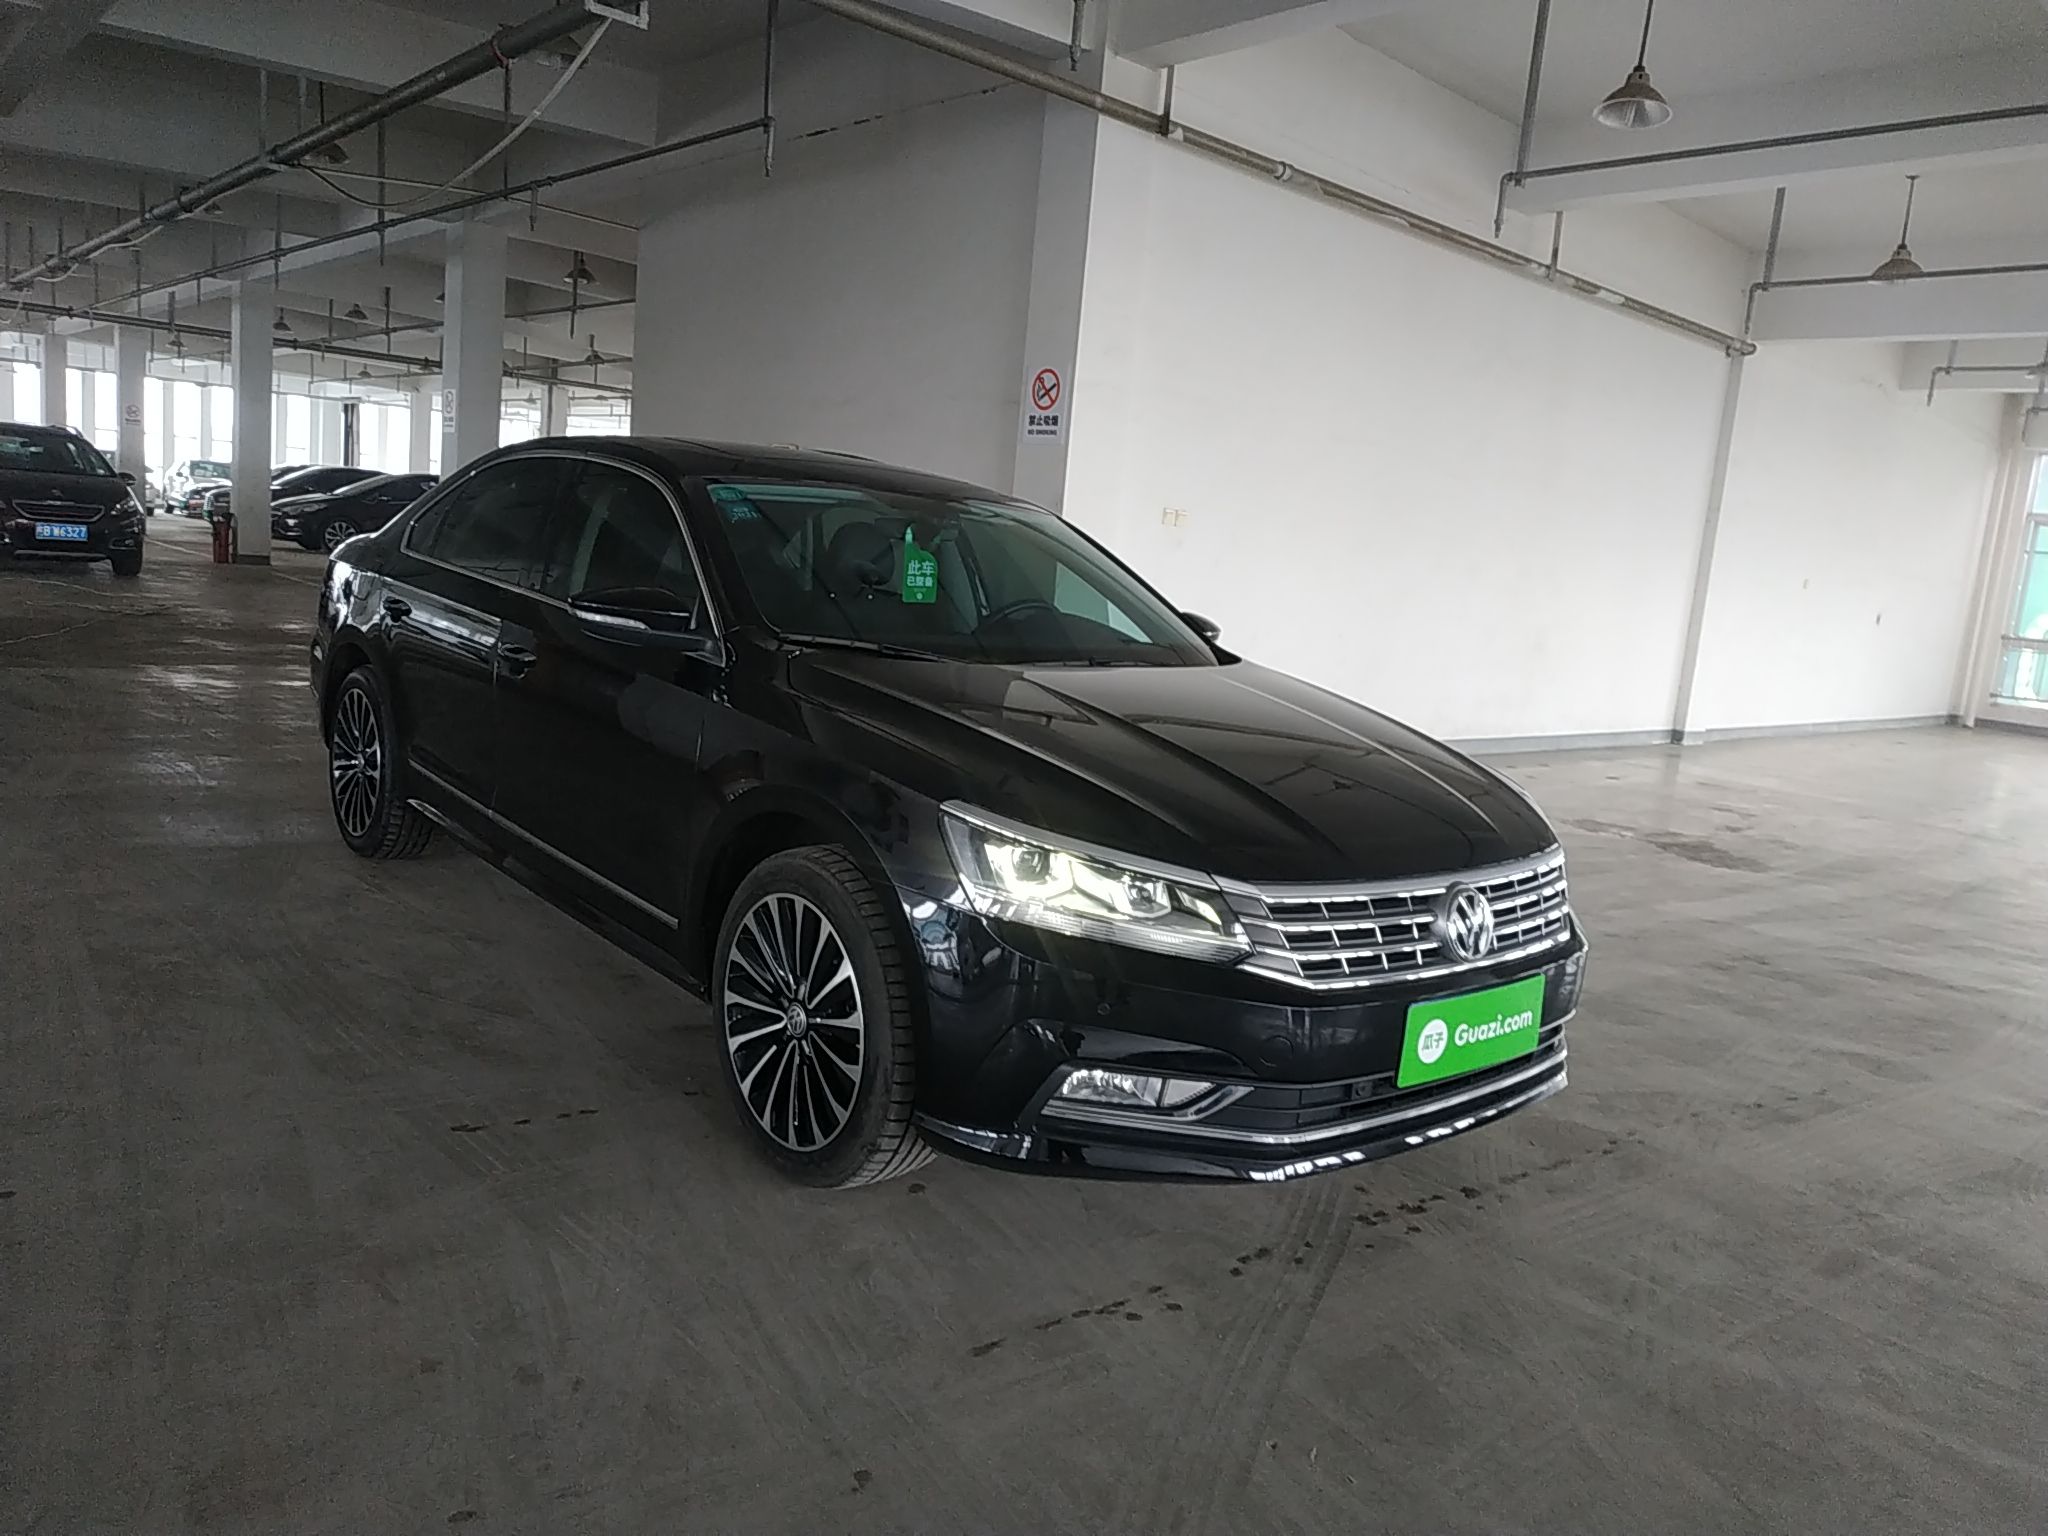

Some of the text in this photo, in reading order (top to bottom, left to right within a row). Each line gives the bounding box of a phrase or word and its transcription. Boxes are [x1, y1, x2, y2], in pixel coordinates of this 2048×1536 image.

[1028, 414, 1059, 427] 禁止吸烟
[907, 560, 935, 576] 此车
[1454, 1010, 1533, 1047] Guazi.com
[1422, 1031, 1444, 1051] 瓜子
